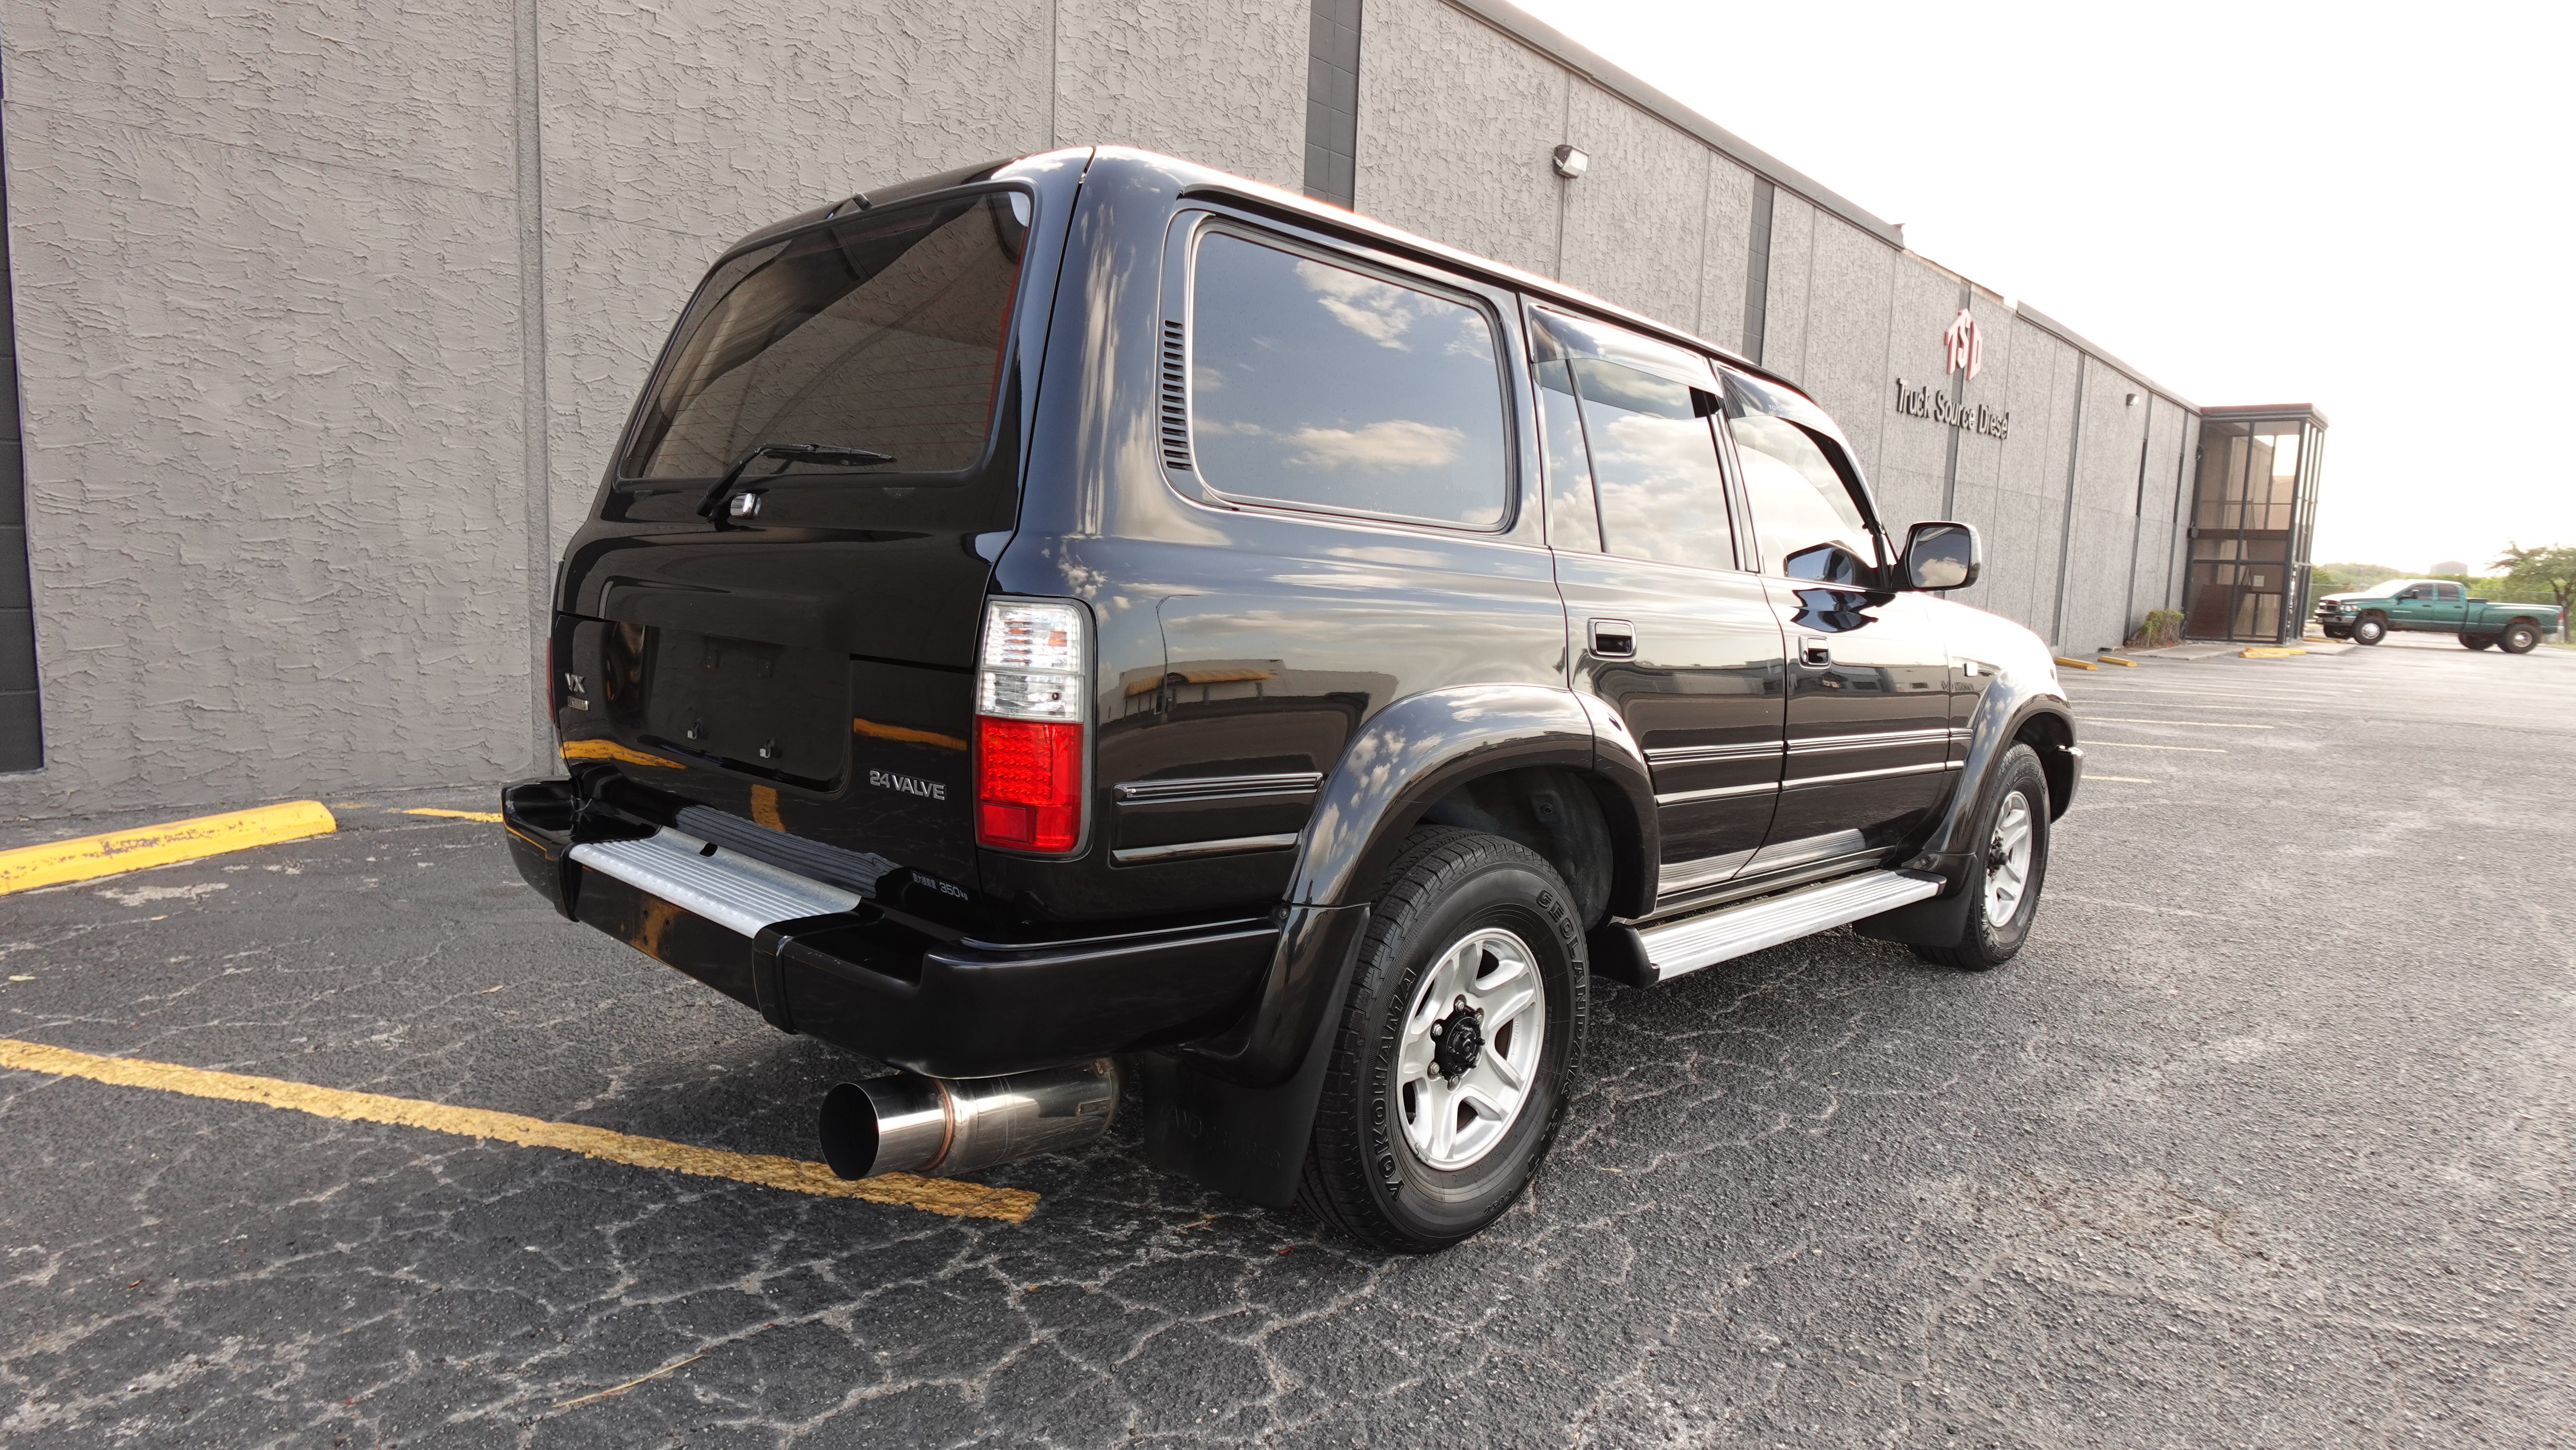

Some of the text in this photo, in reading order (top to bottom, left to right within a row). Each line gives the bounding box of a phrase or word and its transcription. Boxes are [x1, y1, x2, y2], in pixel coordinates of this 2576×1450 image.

[1944, 308, 1983, 381] TSD
[1768, 404, 1788, 413] TOYO
[1896, 378, 2010, 439] Truck Source Diesel
[565, 672, 587, 693] VX
[869, 770, 945, 801] 24 VALVE
[1371, 967, 1417, 1202] YOKOHAMA
